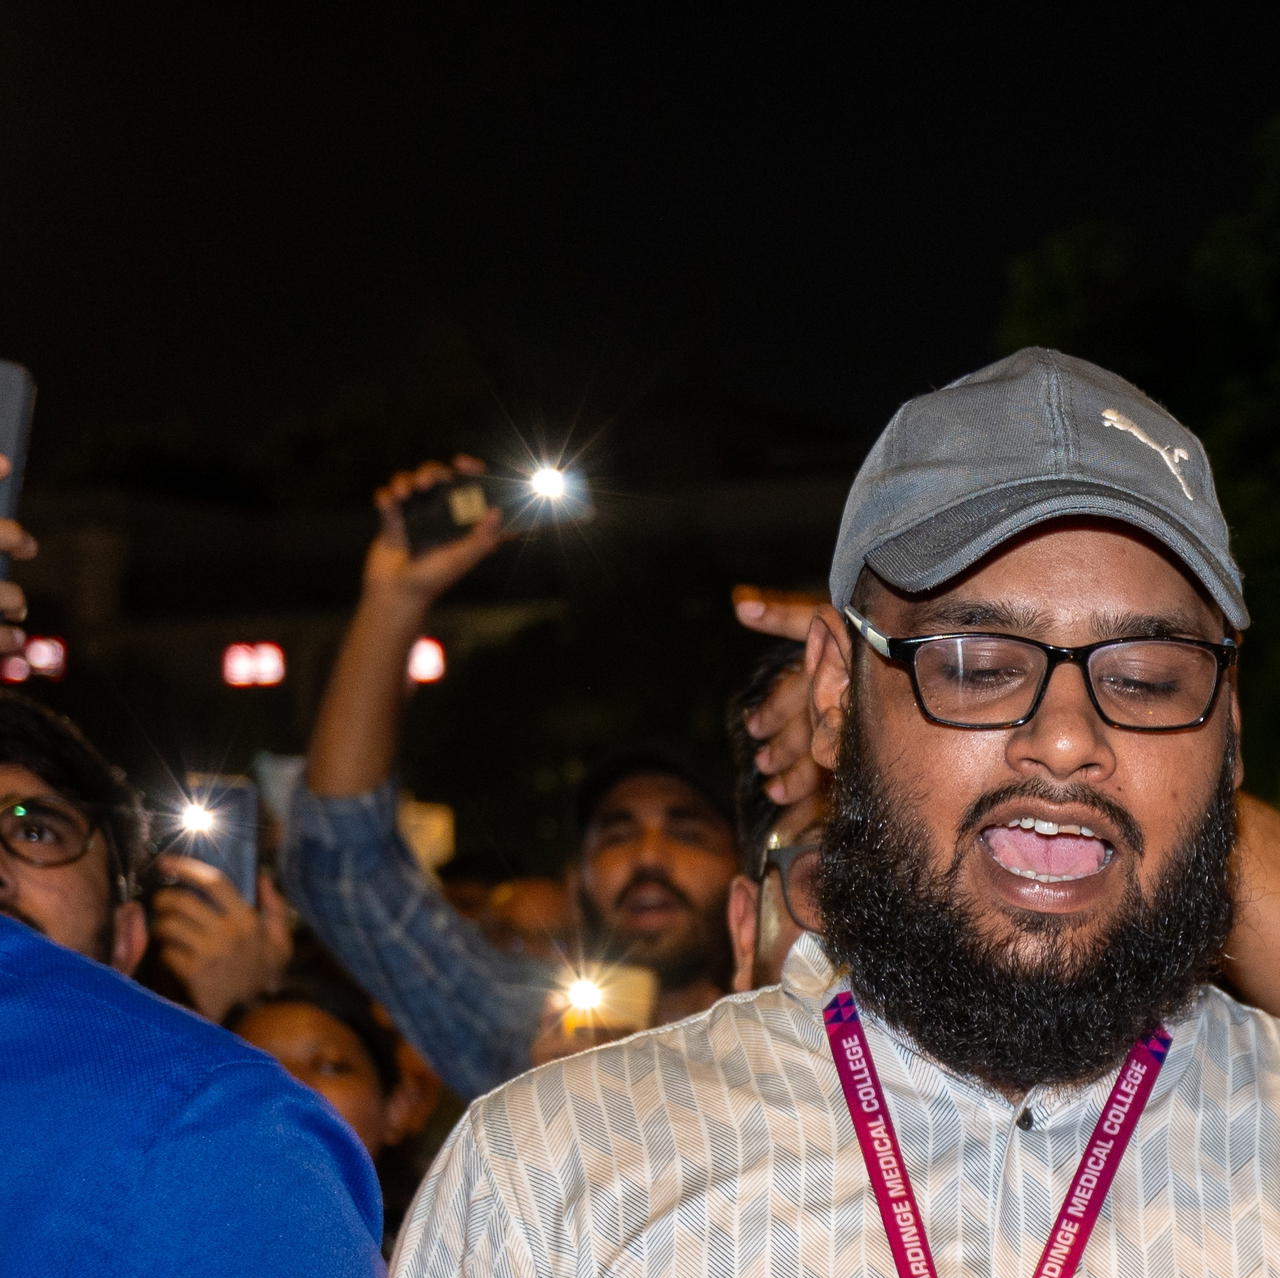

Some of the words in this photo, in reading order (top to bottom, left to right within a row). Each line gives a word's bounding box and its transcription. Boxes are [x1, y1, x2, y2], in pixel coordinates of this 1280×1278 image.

[842, 1035, 880, 1113] COLLEGE
[868, 1114, 904, 1197] MEDICAL
[1067, 1138, 1115, 1219] MEDICAL
[1102, 1059, 1148, 1135] COLLEGE
